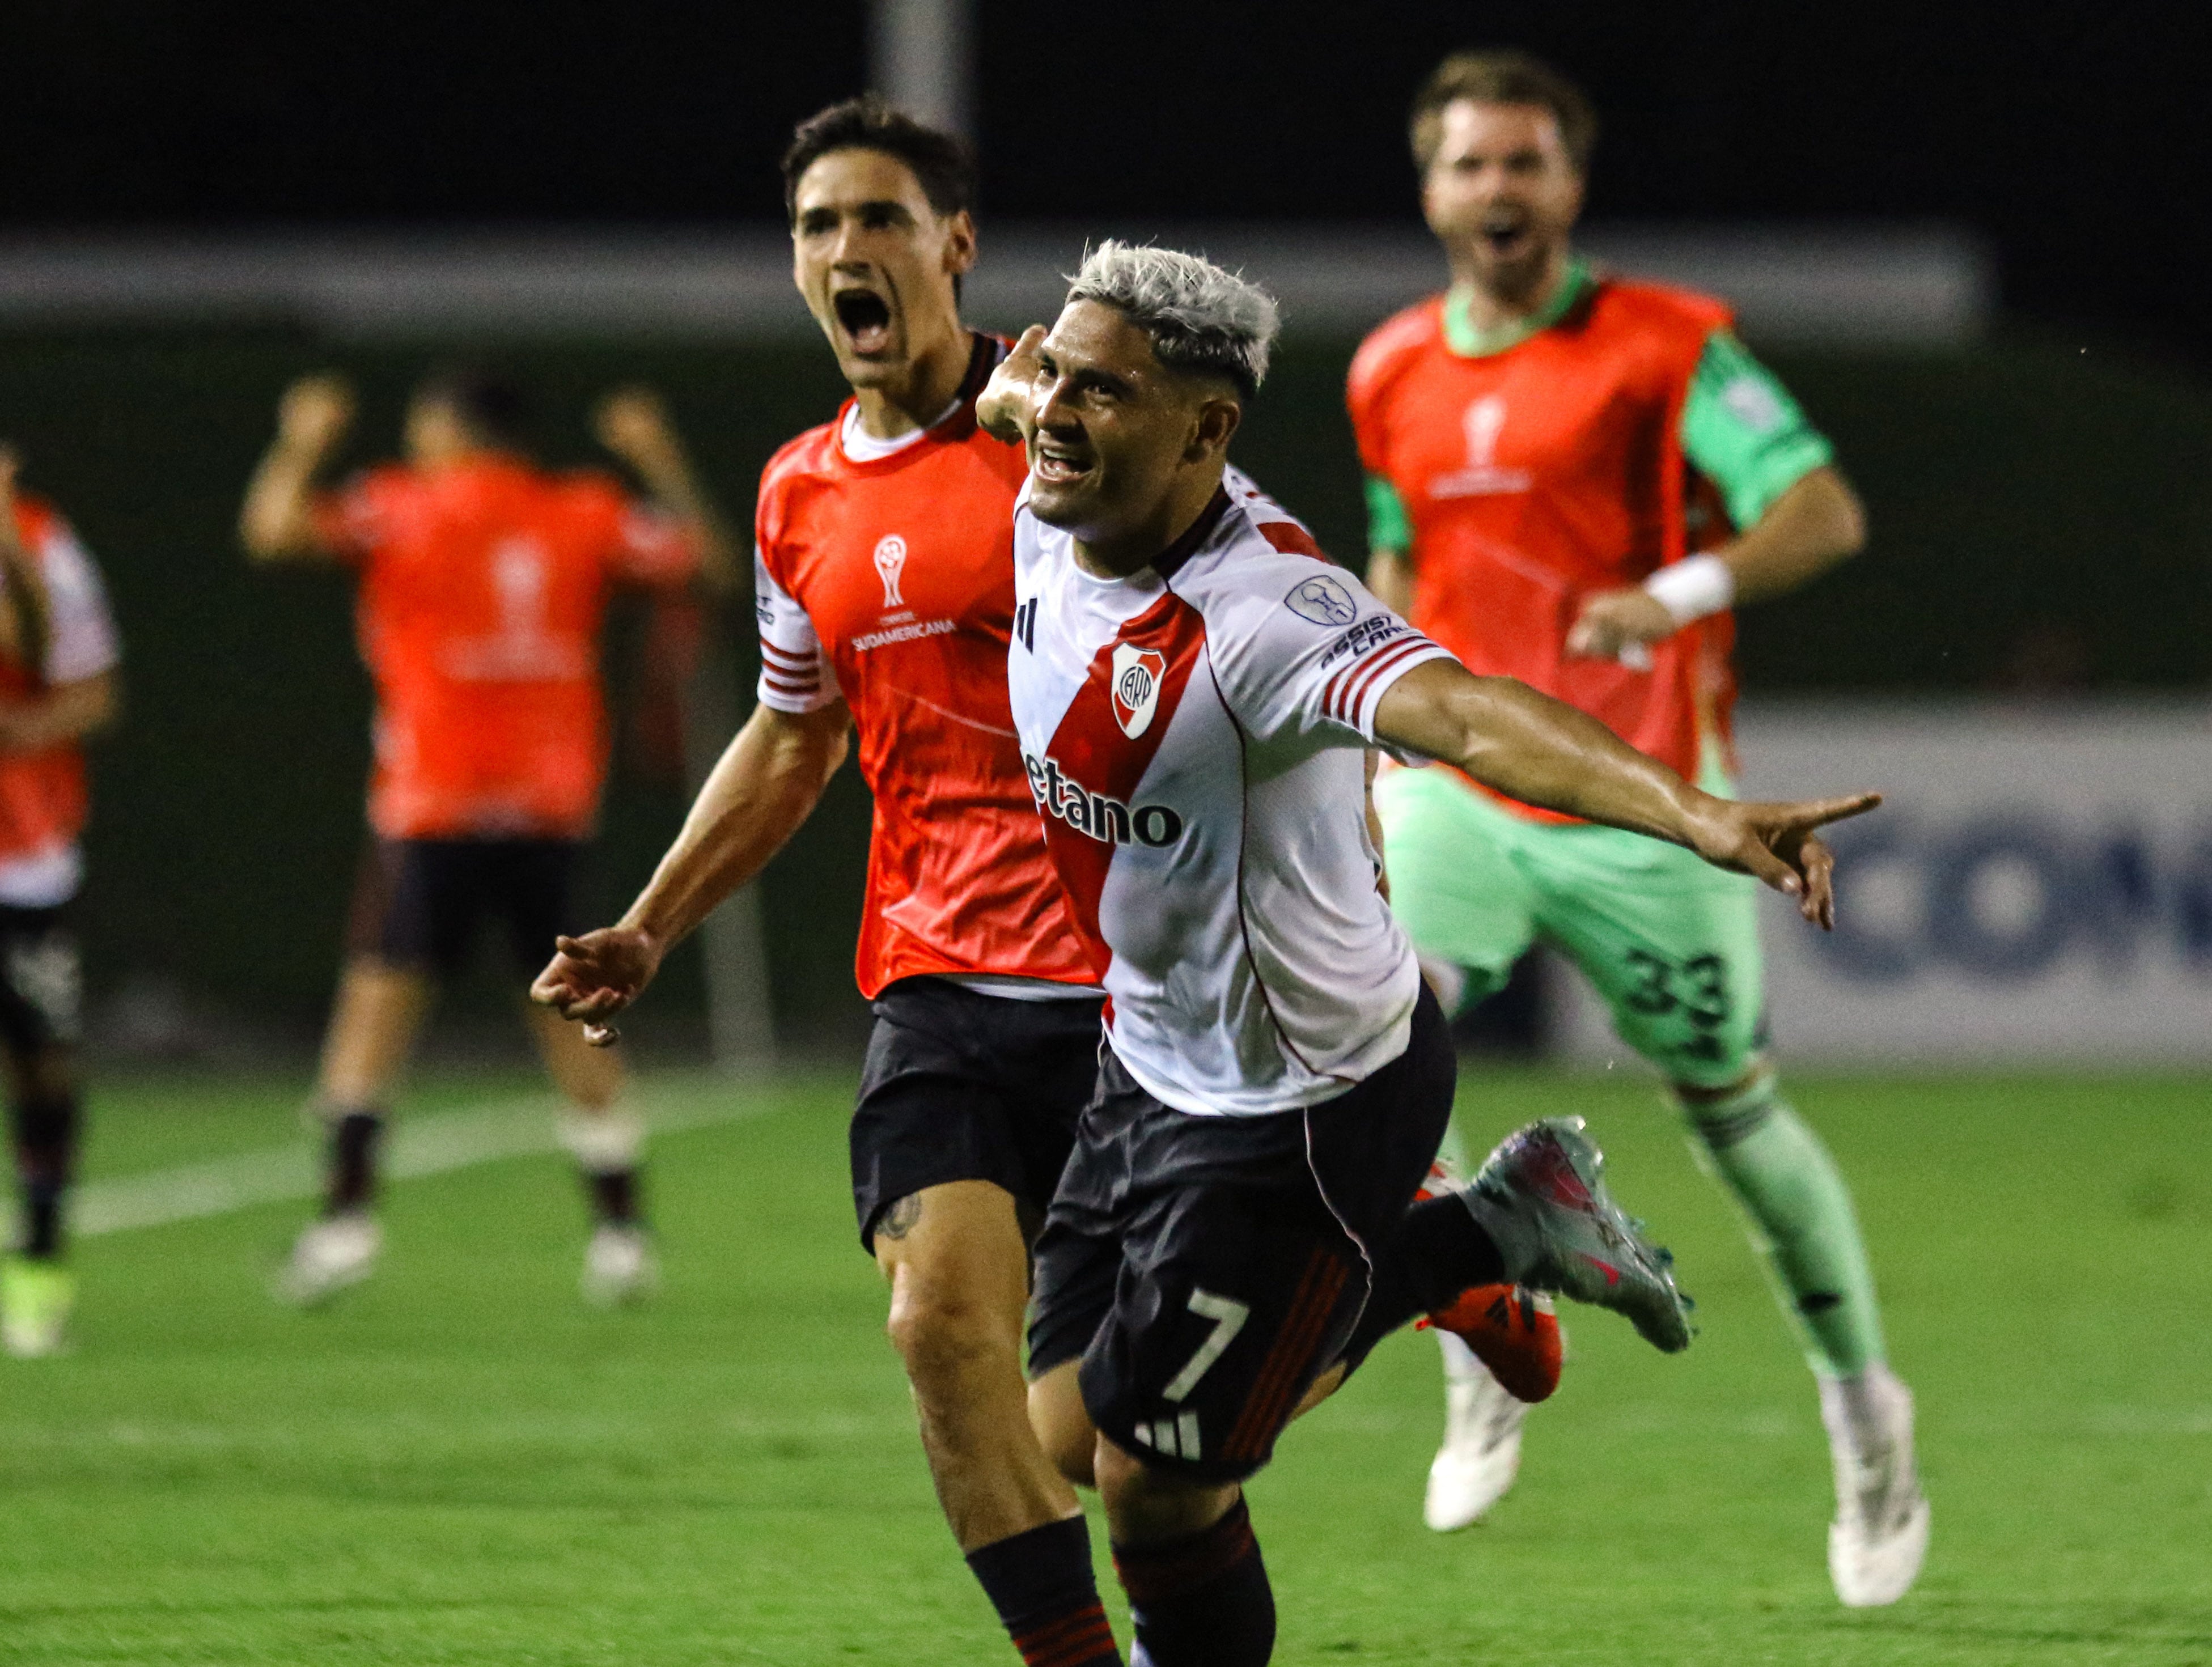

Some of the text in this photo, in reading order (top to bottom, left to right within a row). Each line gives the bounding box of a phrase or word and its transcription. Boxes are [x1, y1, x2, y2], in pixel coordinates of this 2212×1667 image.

[851, 618, 956, 651] SUDAMERICANA
[1353, 627, 1409, 656] CAR
[1024, 754, 1183, 847] etano
[1624, 948, 1727, 1061] 33
[1162, 1287, 1250, 1402] 7
